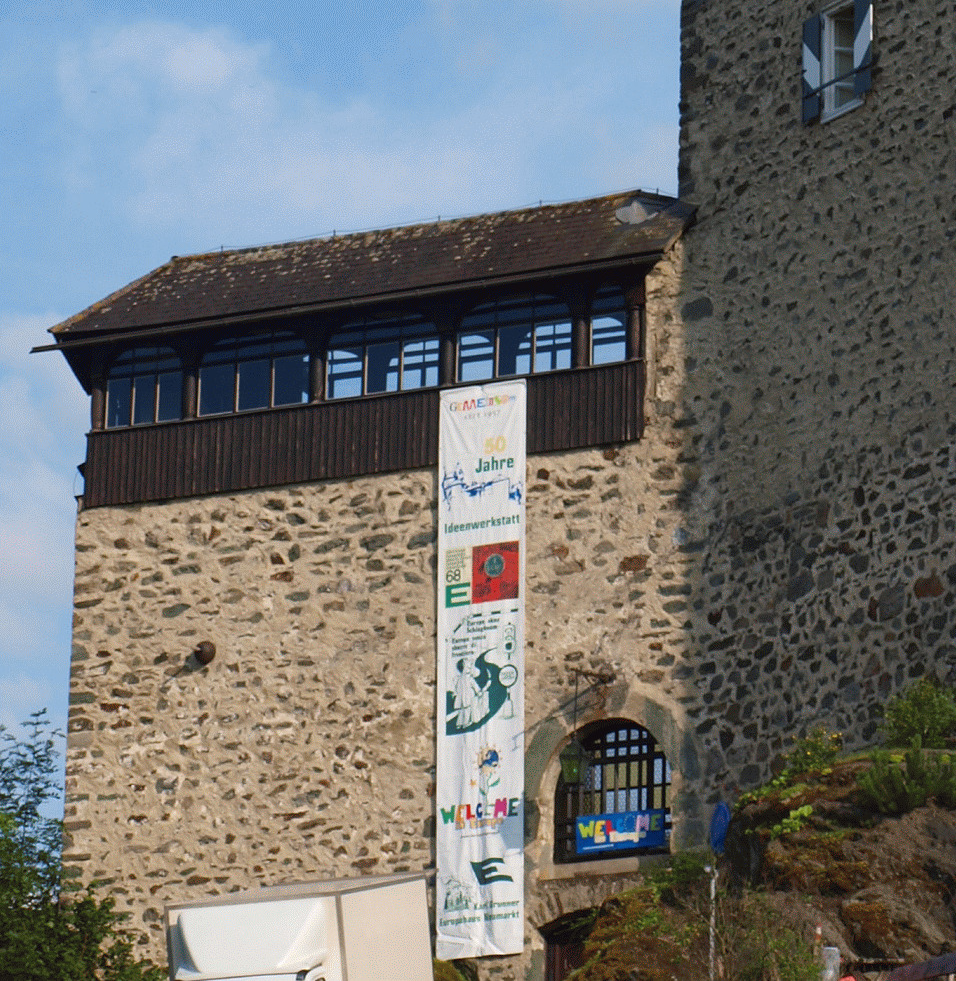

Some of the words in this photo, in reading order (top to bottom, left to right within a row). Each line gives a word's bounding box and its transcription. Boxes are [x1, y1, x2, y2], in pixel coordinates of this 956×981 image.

[484, 435, 506, 455] 50
[475, 455, 514, 473] Jahre
[444, 514, 520, 534] Ideenwerkstatt
[446, 568, 461, 583] 68
[445, 581, 471, 608] E
[440, 797, 519, 824] WELCOME
[578, 813, 661, 839] WELCOME
